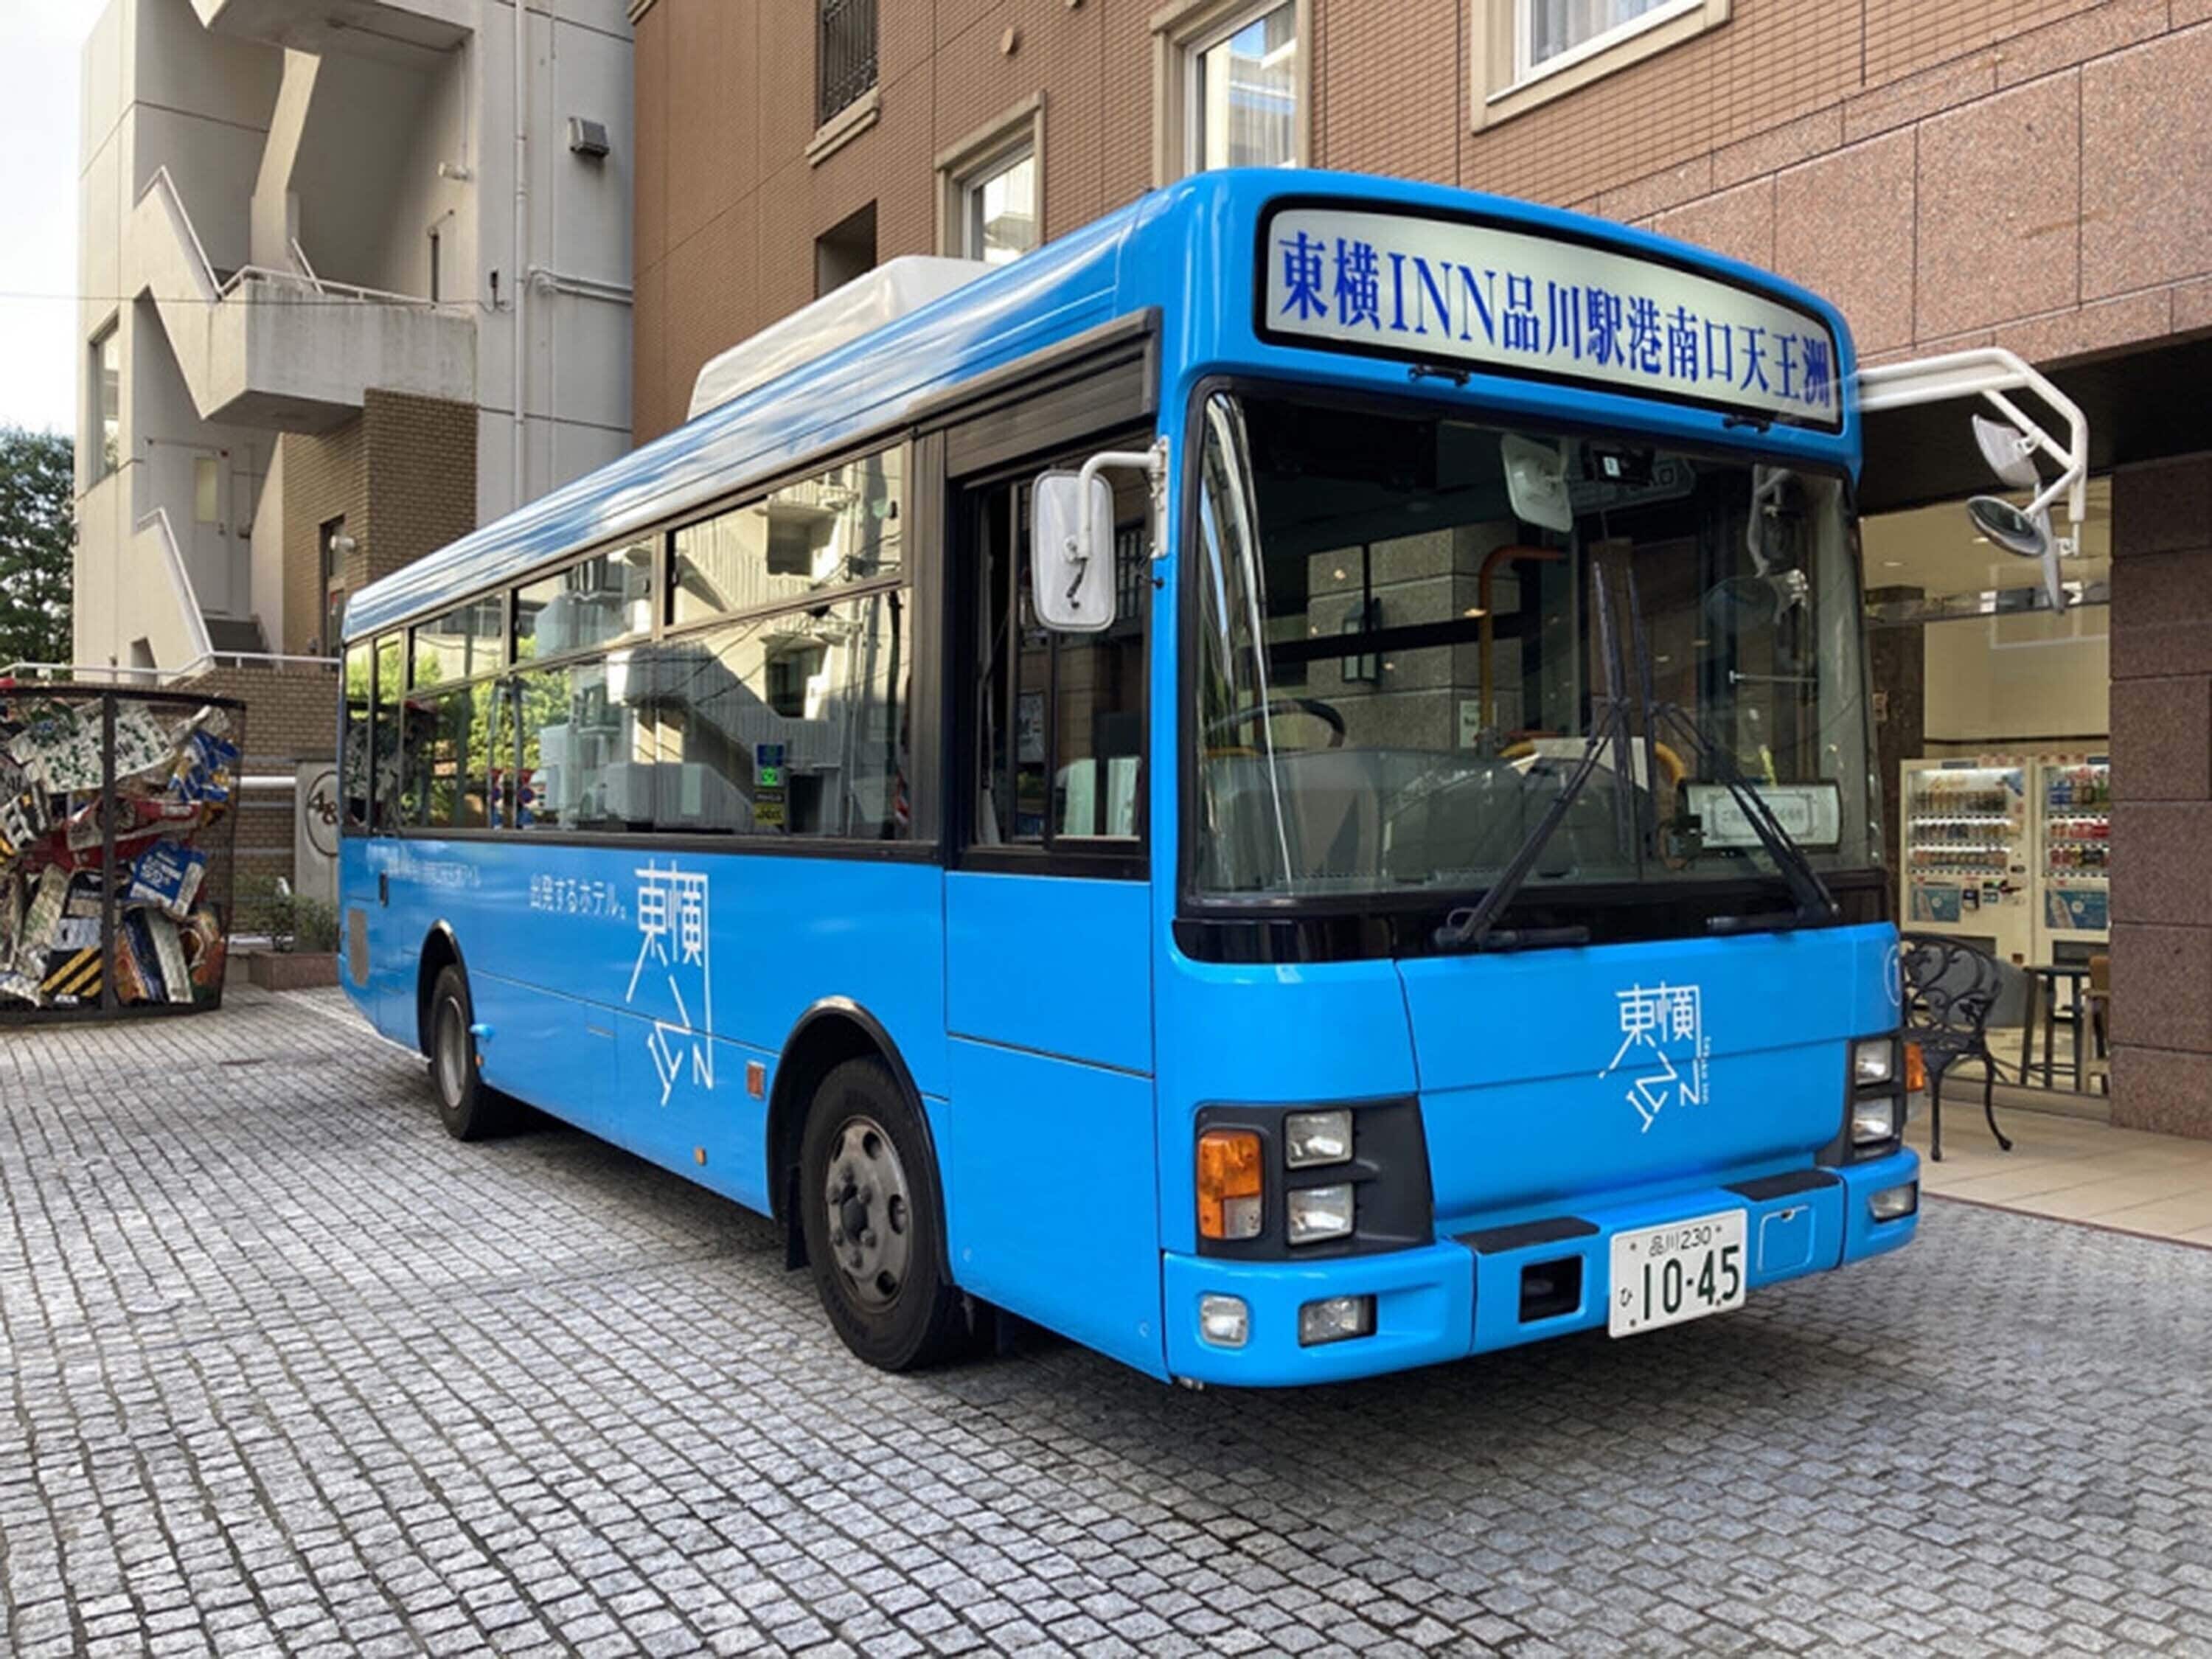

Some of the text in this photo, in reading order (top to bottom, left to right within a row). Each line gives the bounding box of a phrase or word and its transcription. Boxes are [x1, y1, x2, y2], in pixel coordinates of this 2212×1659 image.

[1279, 231, 1830, 408] 東横INN品川駅港南口天王洲
